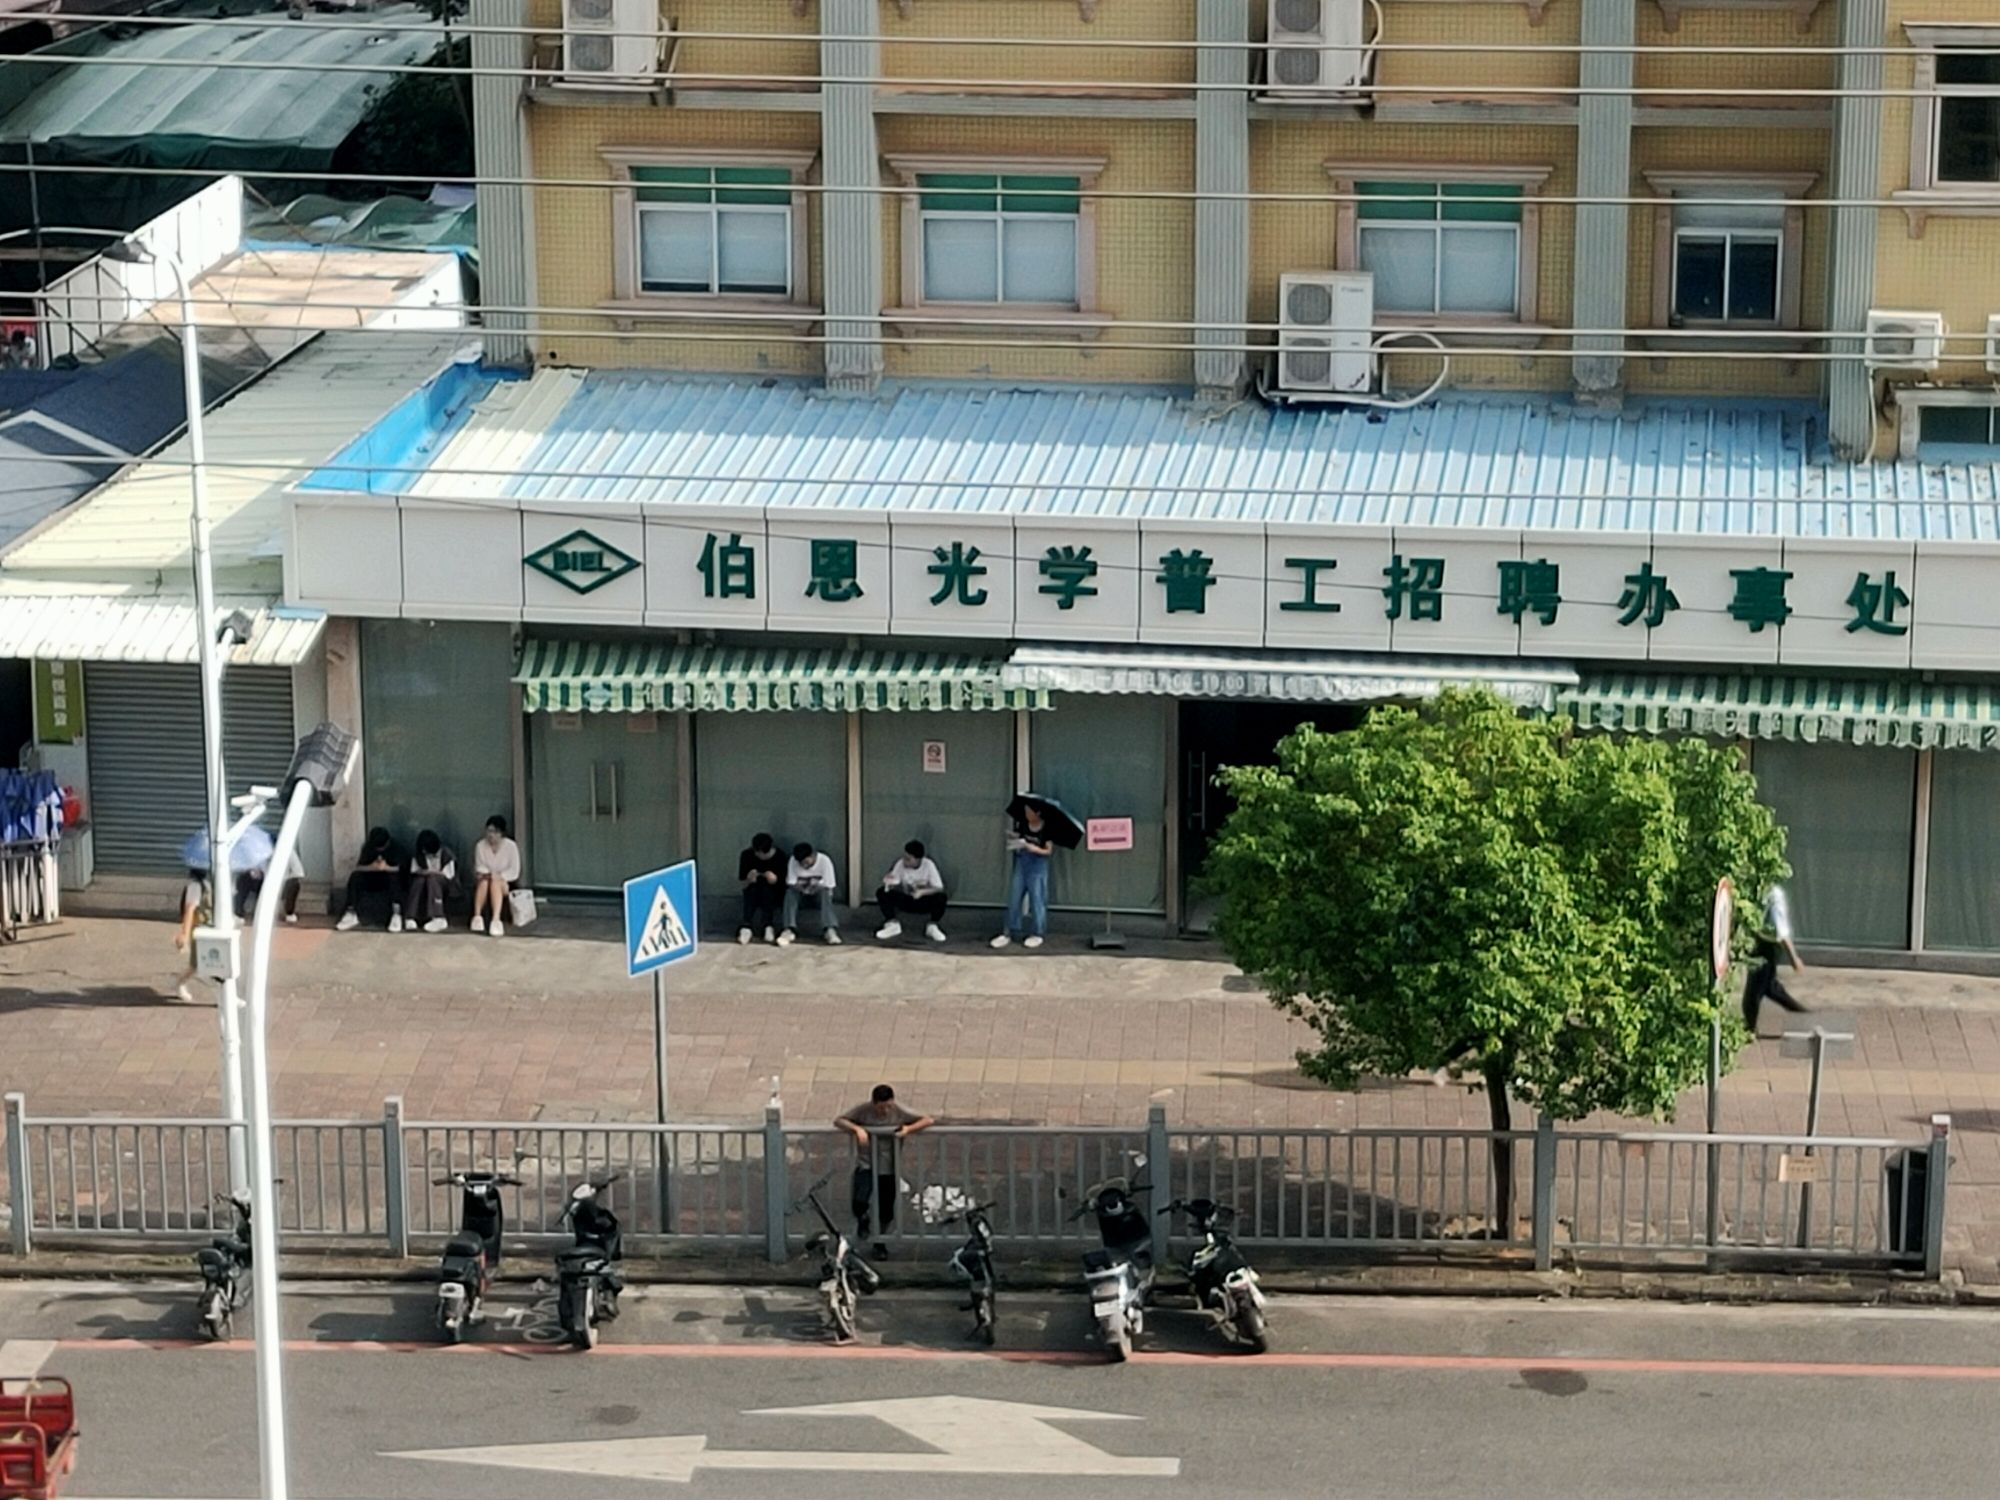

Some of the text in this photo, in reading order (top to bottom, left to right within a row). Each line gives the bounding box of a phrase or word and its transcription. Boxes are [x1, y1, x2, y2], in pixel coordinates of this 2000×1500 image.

[553, 550, 612, 572] BIEL
[697, 534, 1909, 637] 伯恩光学普工招聘办事处
